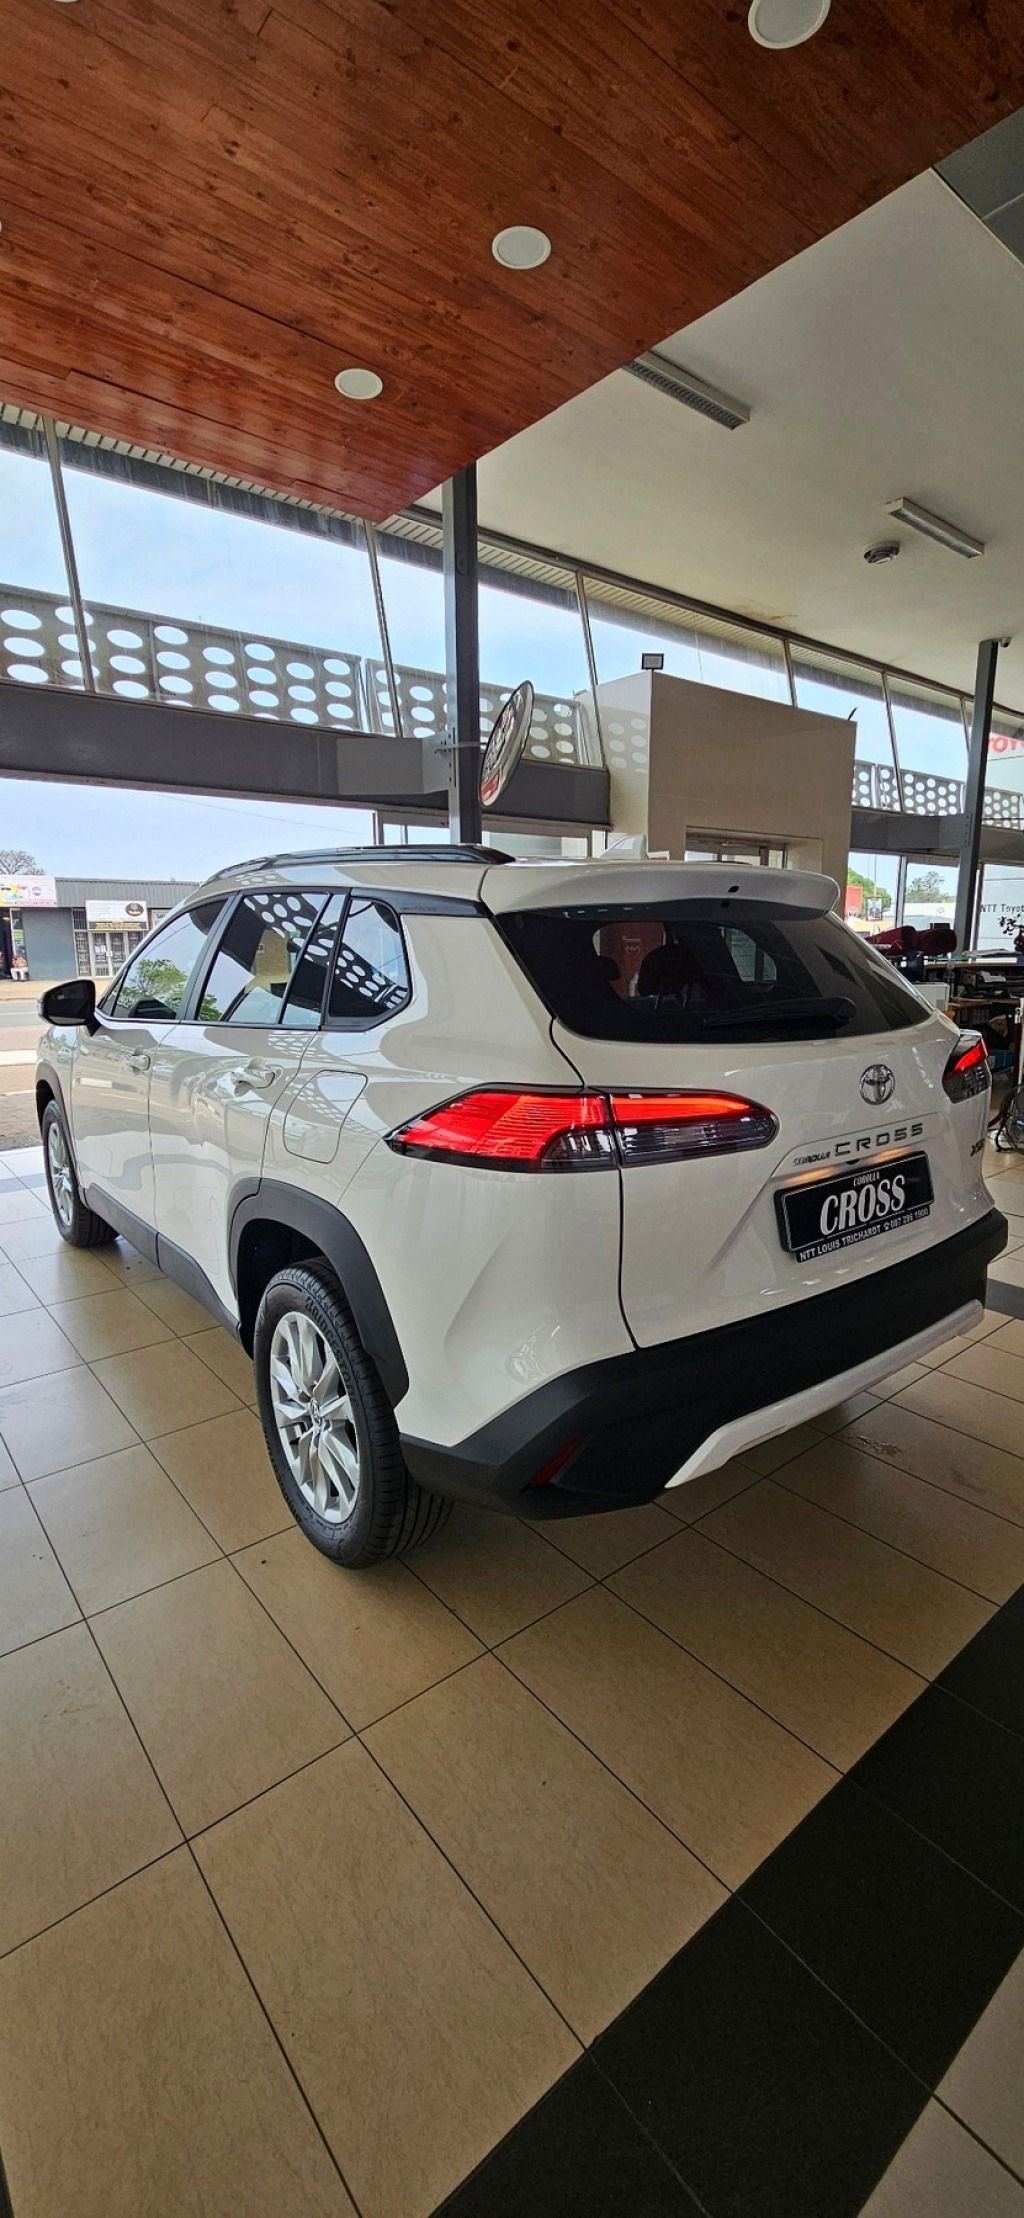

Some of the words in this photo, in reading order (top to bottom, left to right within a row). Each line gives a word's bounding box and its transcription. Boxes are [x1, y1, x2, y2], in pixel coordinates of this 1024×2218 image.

[835, 1123, 923, 1157] CROSS
[853, 1170, 880, 1188] COROLLA
[820, 1174, 906, 1236] CROSS
[799, 1247, 816, 1262] NTT
[817, 1239, 841, 1255] LOUIS
[842, 1224, 882, 1246] TRICHARDT
[304, 1295, 359, 1406] BRIDGESTONE
